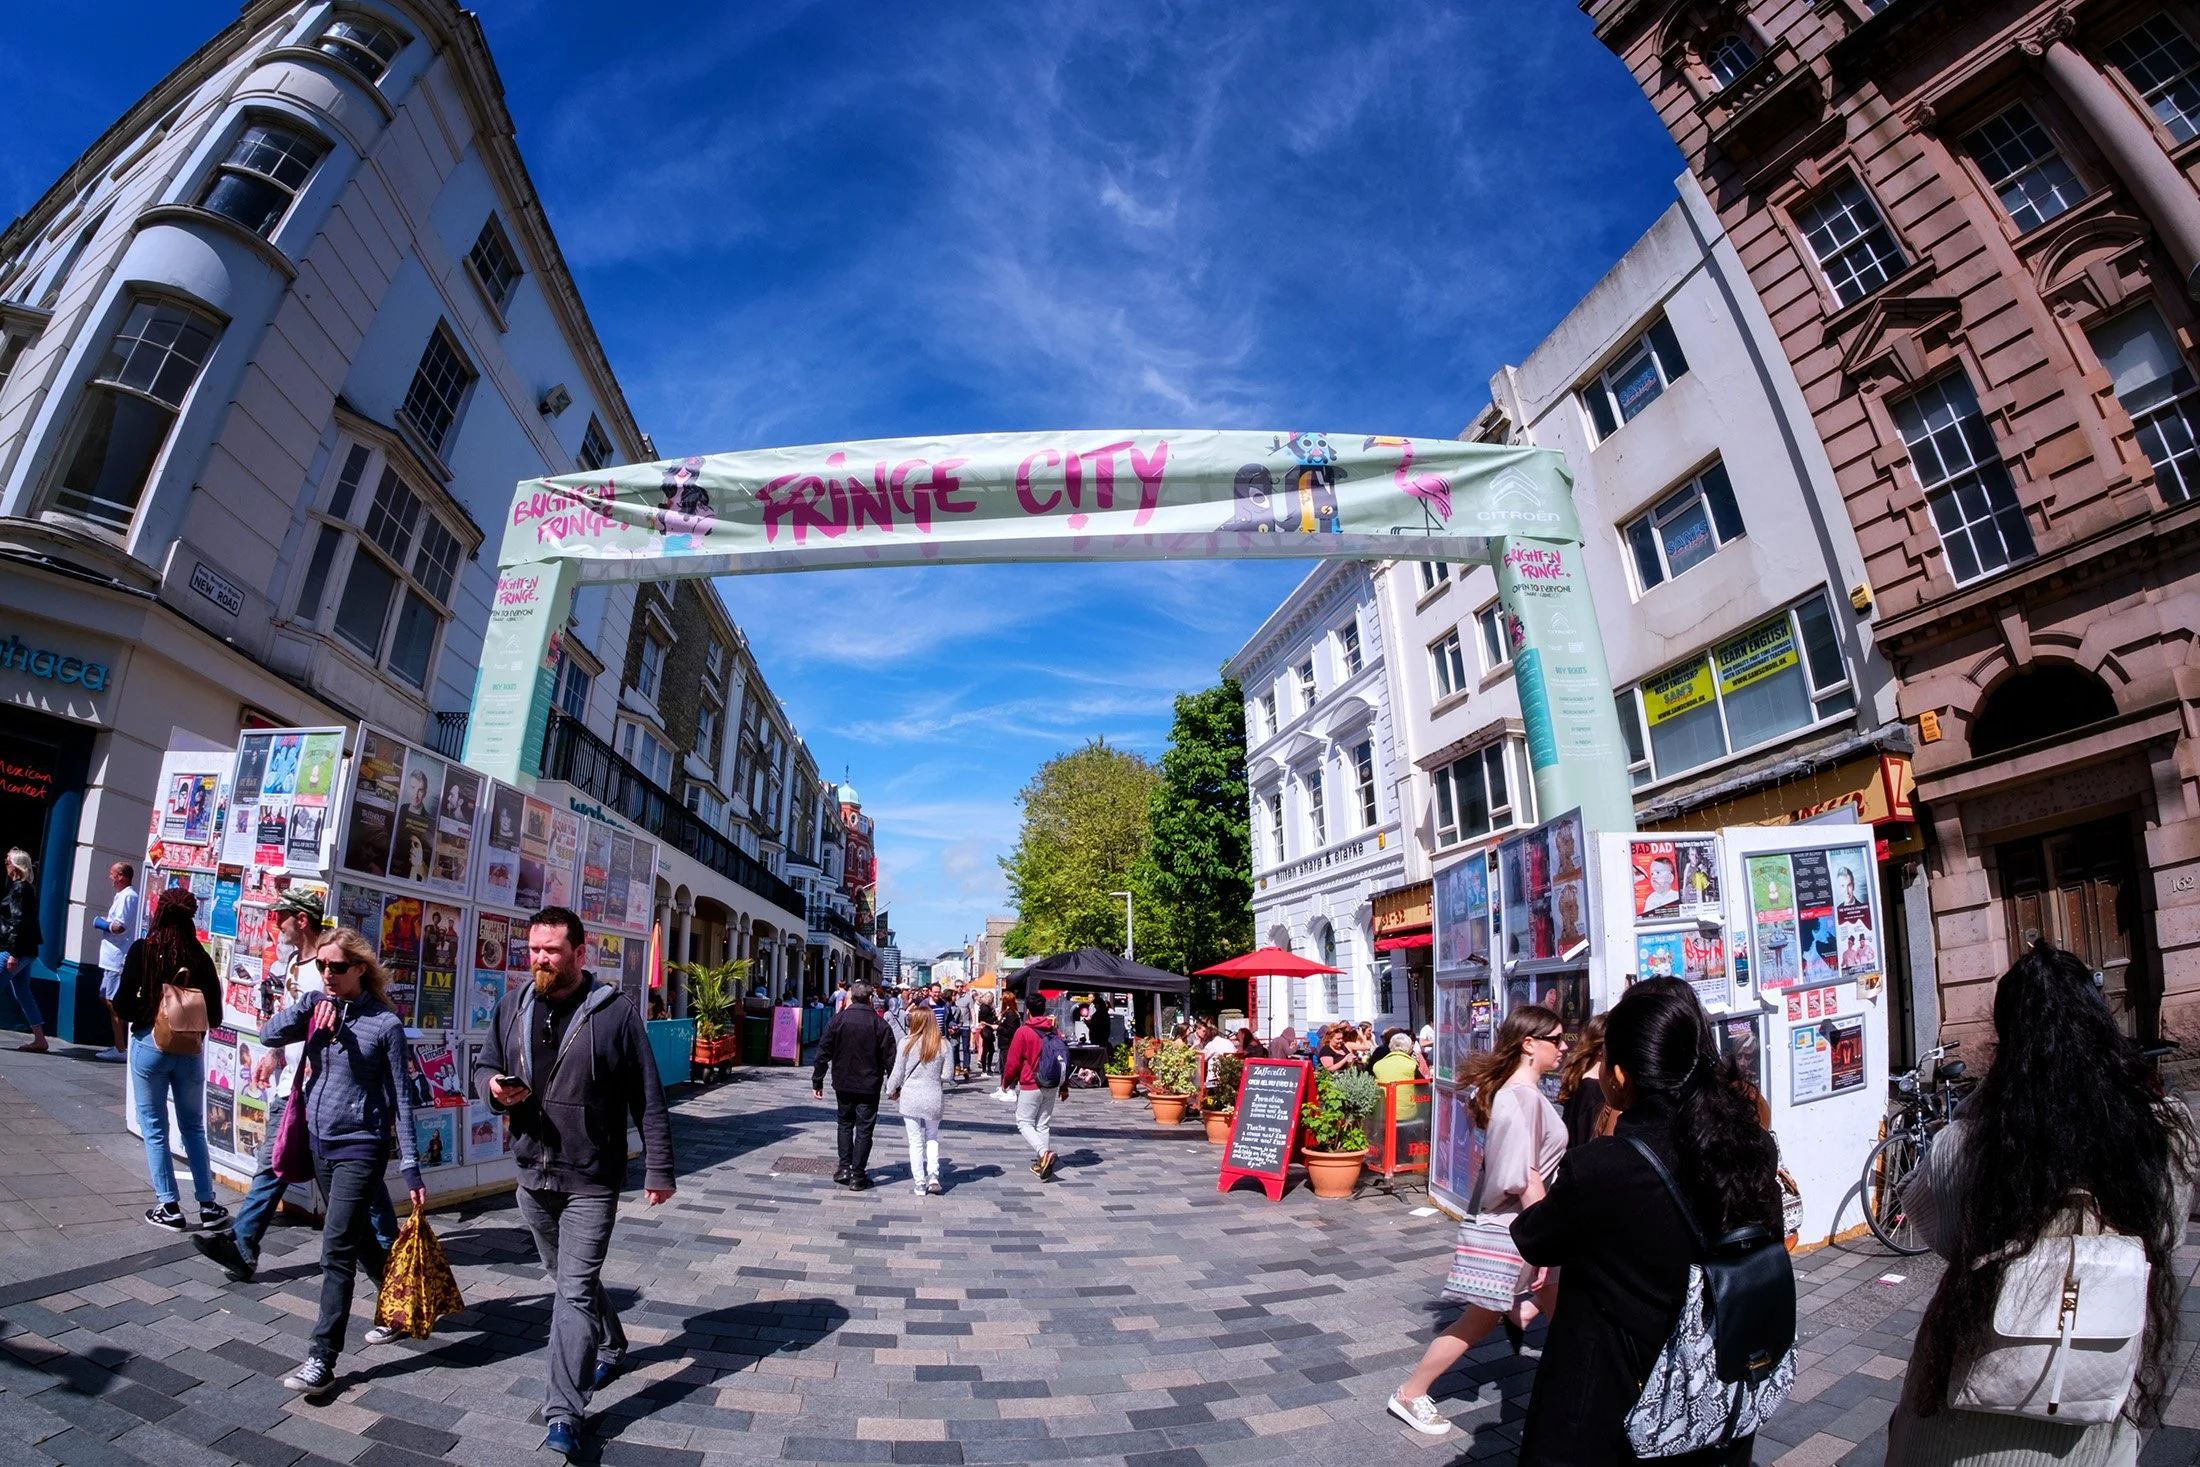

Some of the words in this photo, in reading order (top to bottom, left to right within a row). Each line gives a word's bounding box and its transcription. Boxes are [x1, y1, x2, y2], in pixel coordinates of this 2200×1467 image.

[755, 453, 978, 545] FRINGE
[1016, 441, 1171, 531] CITY
[194, 576, 214, 595] NEW
[217, 590, 239, 611] ROAD
[496, 576, 539, 594] RIGHTON
[1512, 584, 1530, 594] OPEN
[1530, 584, 1540, 592] TO
[1540, 585, 1572, 593] EVERYONE
[1720, 643, 1748, 666] LEARN
[1748, 624, 1789, 653] ENGLISH
[1300, 858, 1322, 876] sharp
[1325, 852, 1332, 867] &
[1334, 841, 1364, 863] clarke
[2171, 876, 2194, 893] 162
